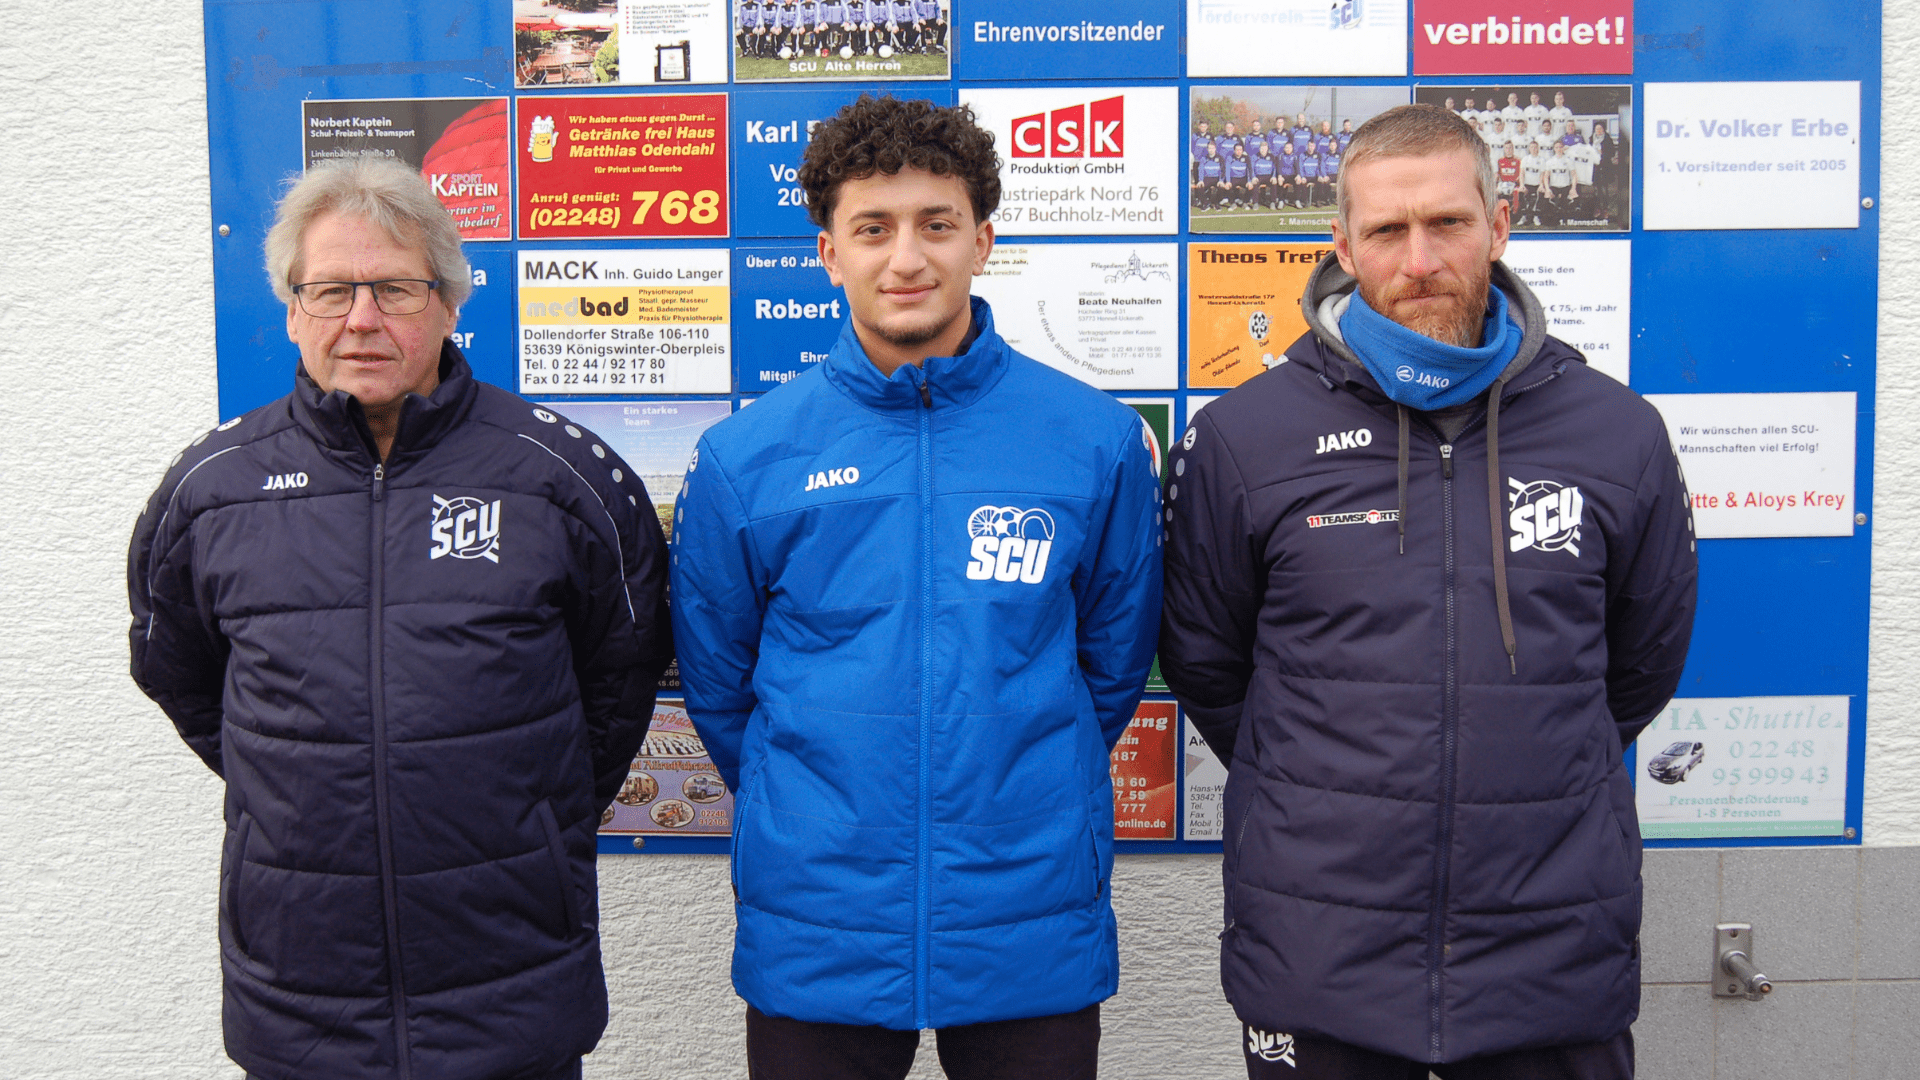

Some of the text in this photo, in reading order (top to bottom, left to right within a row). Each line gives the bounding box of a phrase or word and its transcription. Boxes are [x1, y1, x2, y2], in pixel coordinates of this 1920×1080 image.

[974, 20, 1164, 42] Ehrenvorsitzender
[1424, 16, 1624, 45] verbindet!
[789, 61, 901, 72] SCU Alte Herren
[310, 117, 392, 128] Norbert Kaptein
[569, 116, 586, 124] Wir
[589, 116, 617, 124] haben
[650, 116, 677, 124] gegen
[679, 114, 706, 122] Durst
[310, 130, 334, 138] Schul-
[376, 128, 415, 138] Teamsport
[569, 127, 715, 141] Getränke frei Haus
[746, 120, 798, 142] Karl
[1656, 118, 1849, 138] Dr. Volker Erbe
[1014, 120, 1122, 154] CSK
[386, 149, 396, 157] 30
[570, 143, 716, 158] Matthias Odendahl
[594, 166, 606, 174] für
[1010, 162, 1124, 174] Produktion GmbH
[1658, 160, 1846, 172] 1. Vorsitzender seit 2005
[431, 174, 498, 196] KAPTEIN
[451, 174, 482, 184] SPORT
[530, 192, 620, 204] Anruf genügt:
[1001, 186, 1158, 205] ustriepark Nord 76
[482, 203, 496, 212] im
[530, 190, 720, 230] (02248) 768
[1029, 206, 1164, 222] Buchholz-Mendt
[1288, 218, 1332, 226] Mannscha
[1567, 218, 1608, 226] Mannschaft
[746, 255, 824, 268] Über 60 Jah
[1198, 250, 1268, 264] Theos
[525, 261, 724, 281] MACK Inh. Guido Langer
[1538, 266, 1574, 274] Sie den
[639, 289, 694, 297] Physiotherapeut
[526, 296, 628, 316] medbad
[756, 299, 840, 319] Robert
[1596, 304, 1617, 312] Jahr
[662, 314, 672, 322] für
[673, 314, 723, 322] Physiotherapie
[524, 328, 708, 340] Dollendorfer Straße 106-110
[1038, 300, 1134, 376] Der etwas andere Pflegedienst
[524, 344, 725, 356] 53639 Königswinter-Oberpleis
[524, 359, 546, 370] Tel.
[552, 359, 559, 369] 0
[564, 359, 578, 369] 22
[583, 359, 598, 369] 44
[610, 358, 626, 369] 92
[631, 358, 645, 368] 17
[650, 358, 665, 368] 80
[524, 374, 548, 384] Fax
[552, 374, 559, 384] 0
[564, 374, 578, 384] 22
[583, 374, 598, 384] 44
[610, 374, 626, 384] 92
[631, 374, 645, 384] 17
[650, 373, 664, 384] 81
[1416, 372, 1450, 388] JAKO
[642, 406, 678, 414] starkes
[624, 418, 650, 426] Team
[1680, 425, 1819, 435] Wir wünschen allen SCU-
[1316, 428, 1372, 454] JAKO
[1680, 443, 1819, 453] Mannschaften viel Erfolg!
[262, 472, 308, 490] JAKO
[805, 466, 860, 491] JAKO
[1690, 490, 1845, 511] itte & Aloys Krey
[1510, 486, 1584, 552] SCU
[430, 500, 500, 560] SCU
[966, 536, 1052, 584] SCU
[1113, 752, 1138, 760] 187
[1130, 778, 1146, 786] 60
[1130, 790, 1146, 800] 59
[1669, 795, 1809, 806] Personenbeförderung
[1122, 804, 1146, 812] 777
[1697, 809, 1781, 818] 1-8 Personen
